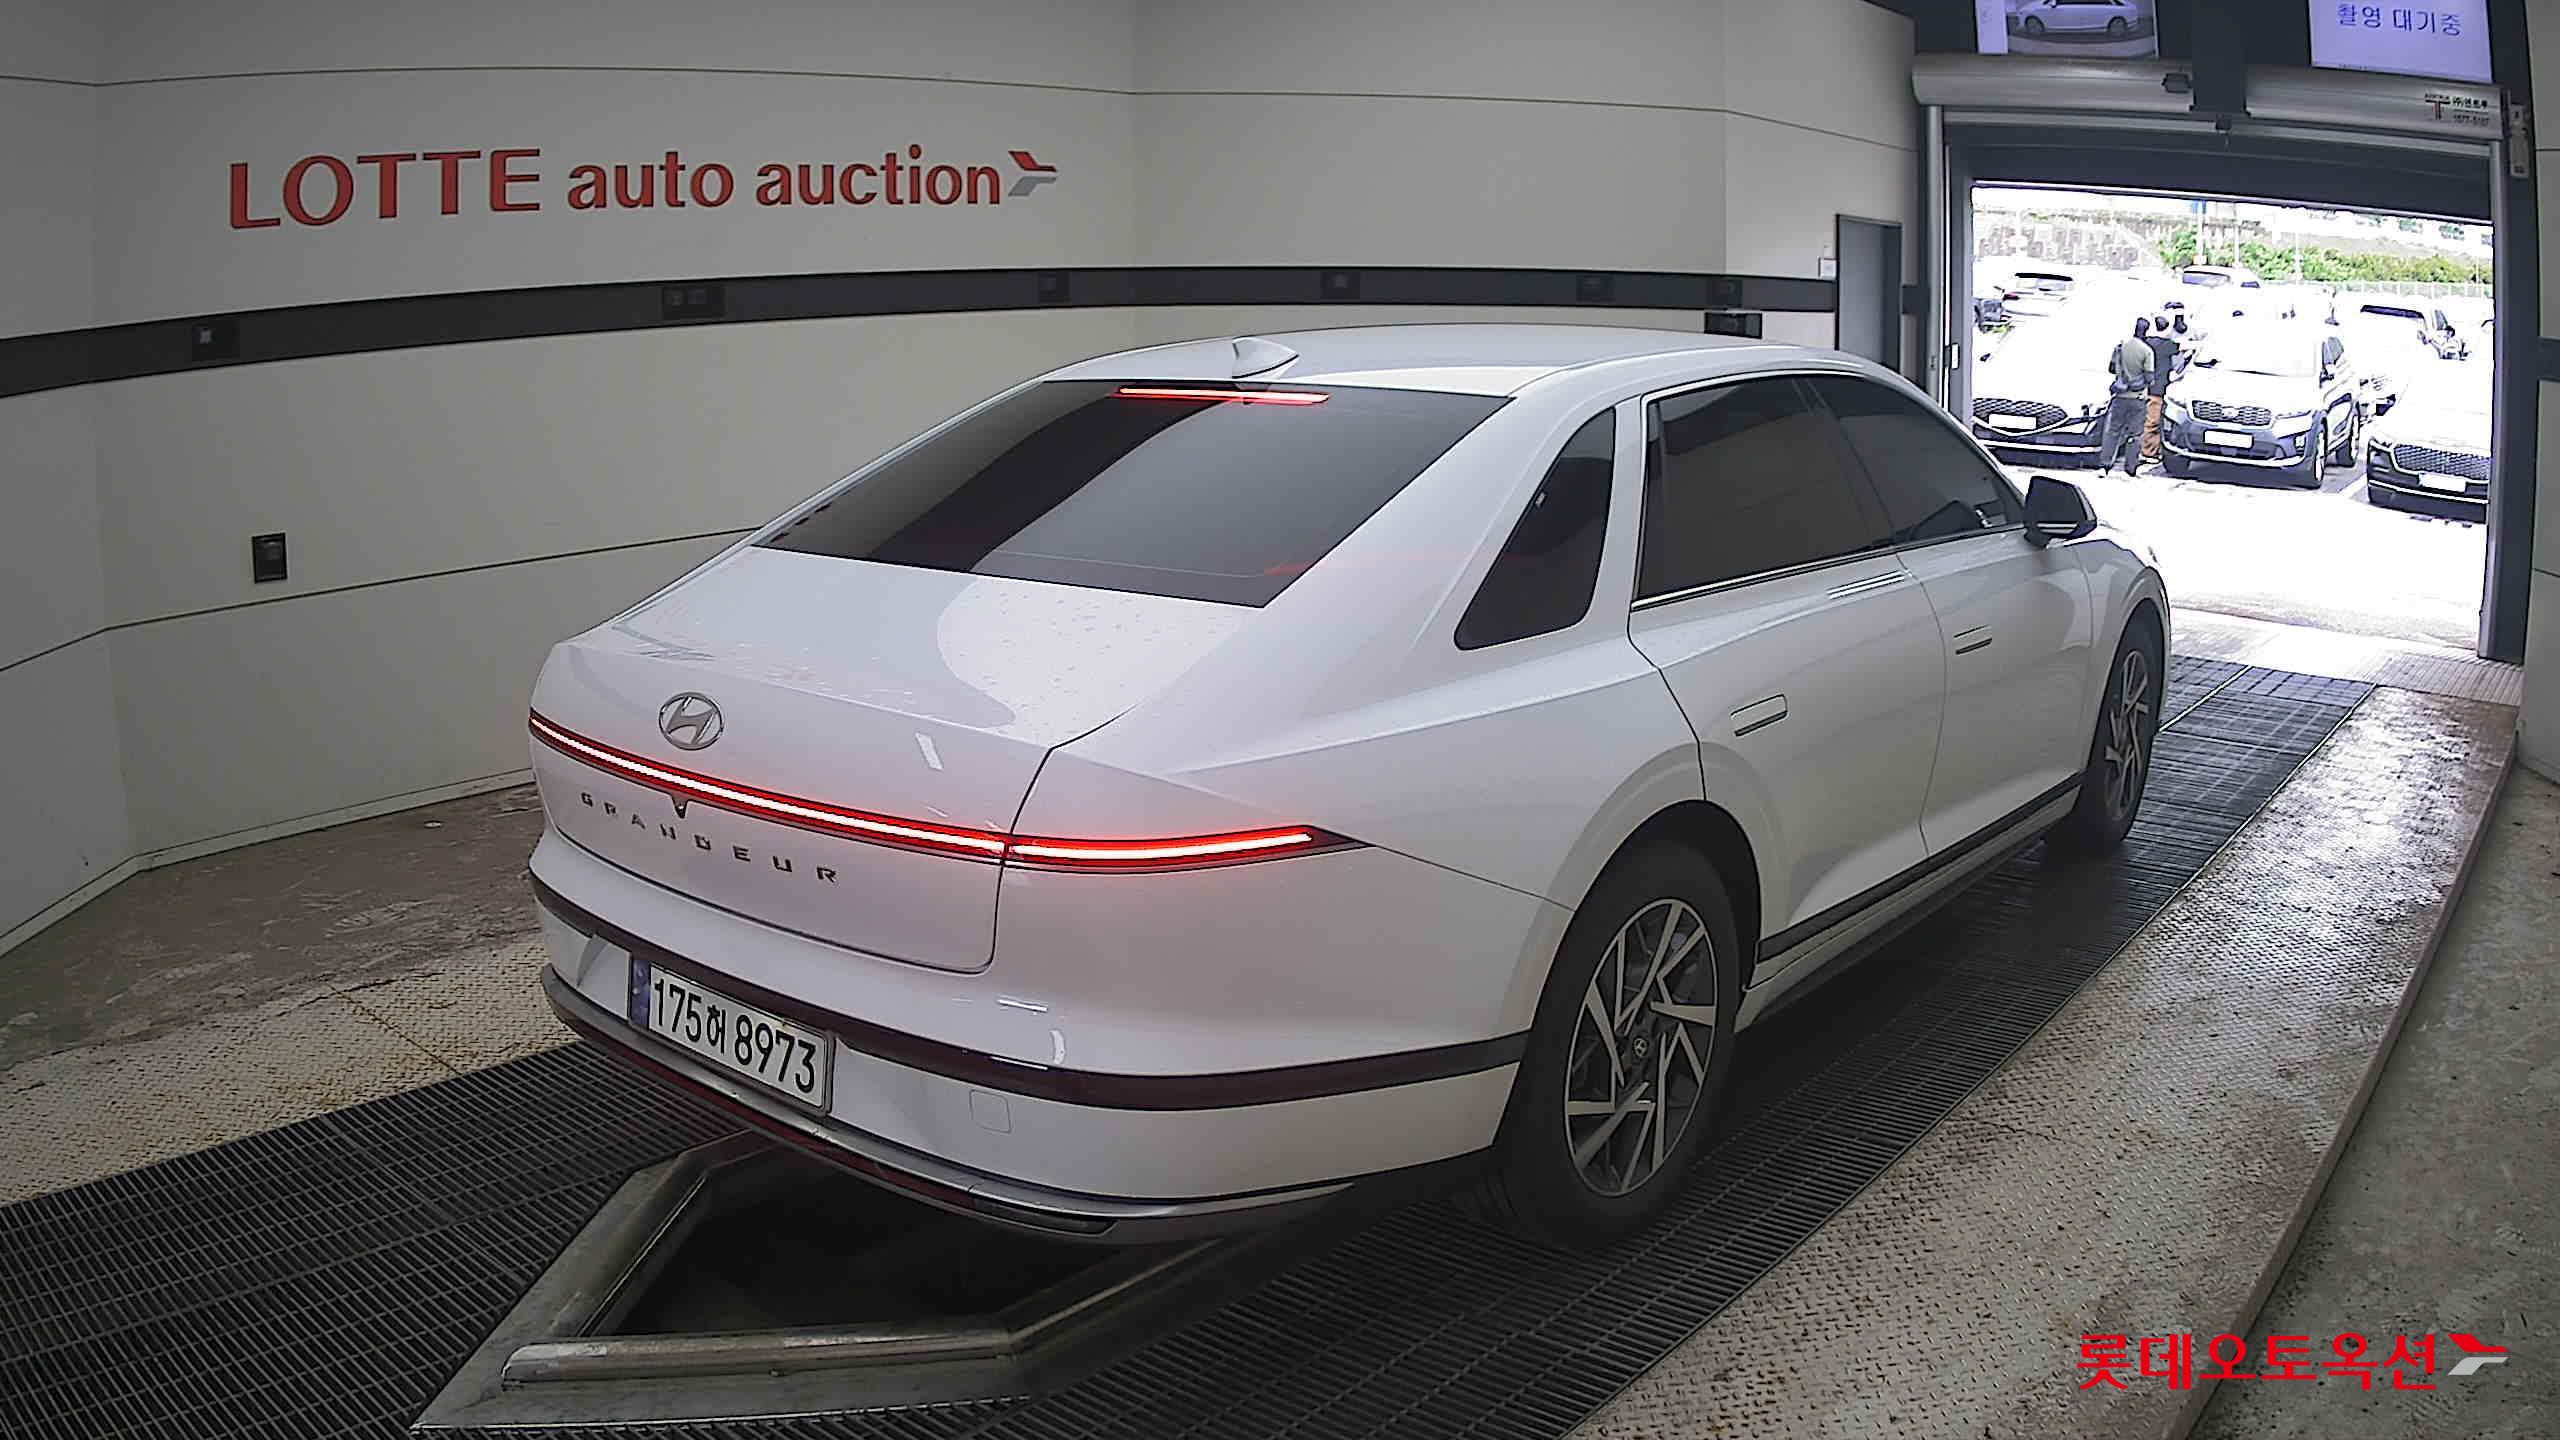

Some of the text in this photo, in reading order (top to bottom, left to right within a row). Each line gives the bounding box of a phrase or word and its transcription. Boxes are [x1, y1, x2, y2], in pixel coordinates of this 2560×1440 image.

[2337, 3, 2462, 37] 촬영 대기중
[229, 143, 1000, 230] LOTTE auto auction
[580, 792, 837, 883] GRANDEUR
[653, 978, 818, 1094] 175허 8973
